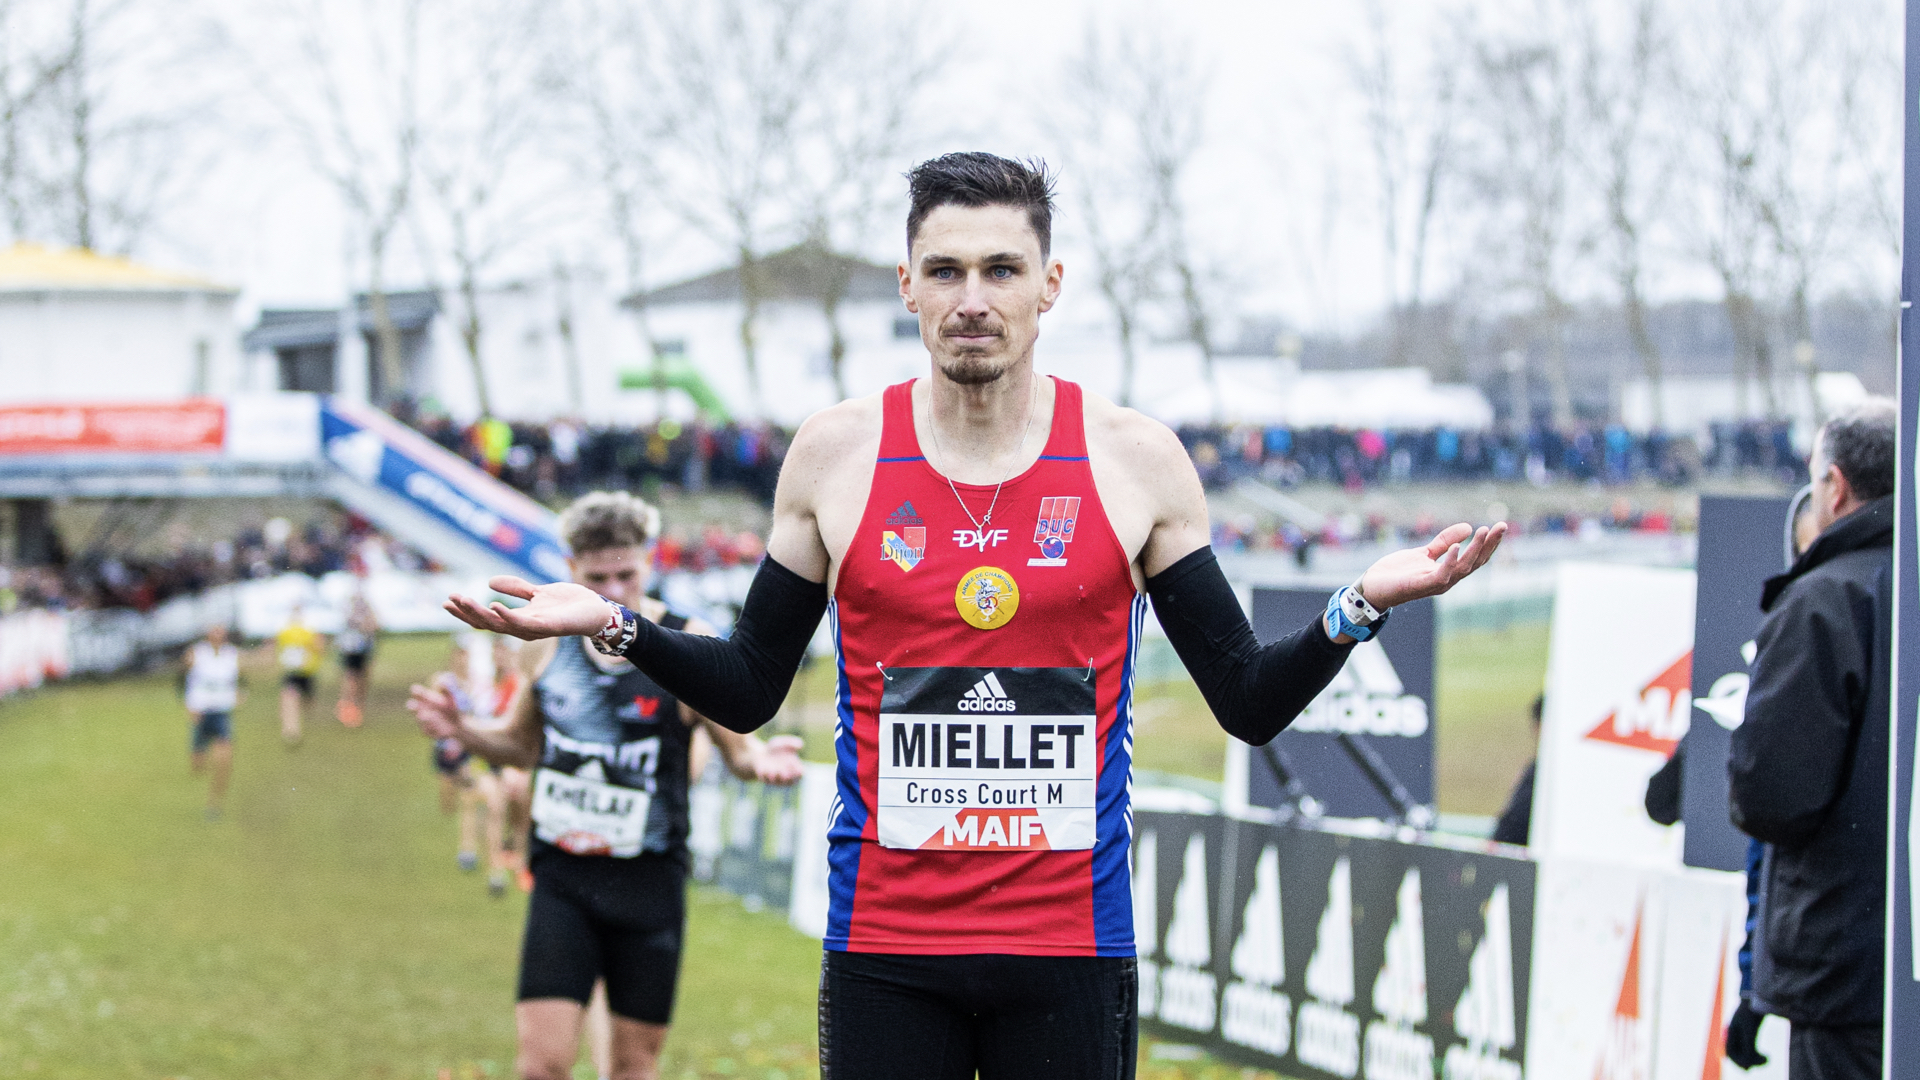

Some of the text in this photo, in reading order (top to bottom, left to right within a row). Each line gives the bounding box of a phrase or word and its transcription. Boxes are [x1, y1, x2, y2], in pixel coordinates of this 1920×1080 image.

[885, 514, 923, 525] adidas
[1038, 519, 1073, 534] DUC
[880, 543, 925, 565] Dijon
[985, 571, 1013, 592] CHAMPIONS
[957, 697, 1016, 712] adidas
[1282, 688, 1429, 737] didas
[892, 722, 1085, 769] MIELLET
[906, 782, 1063, 805] Cross Court M
[943, 815, 1042, 847] MAIF
